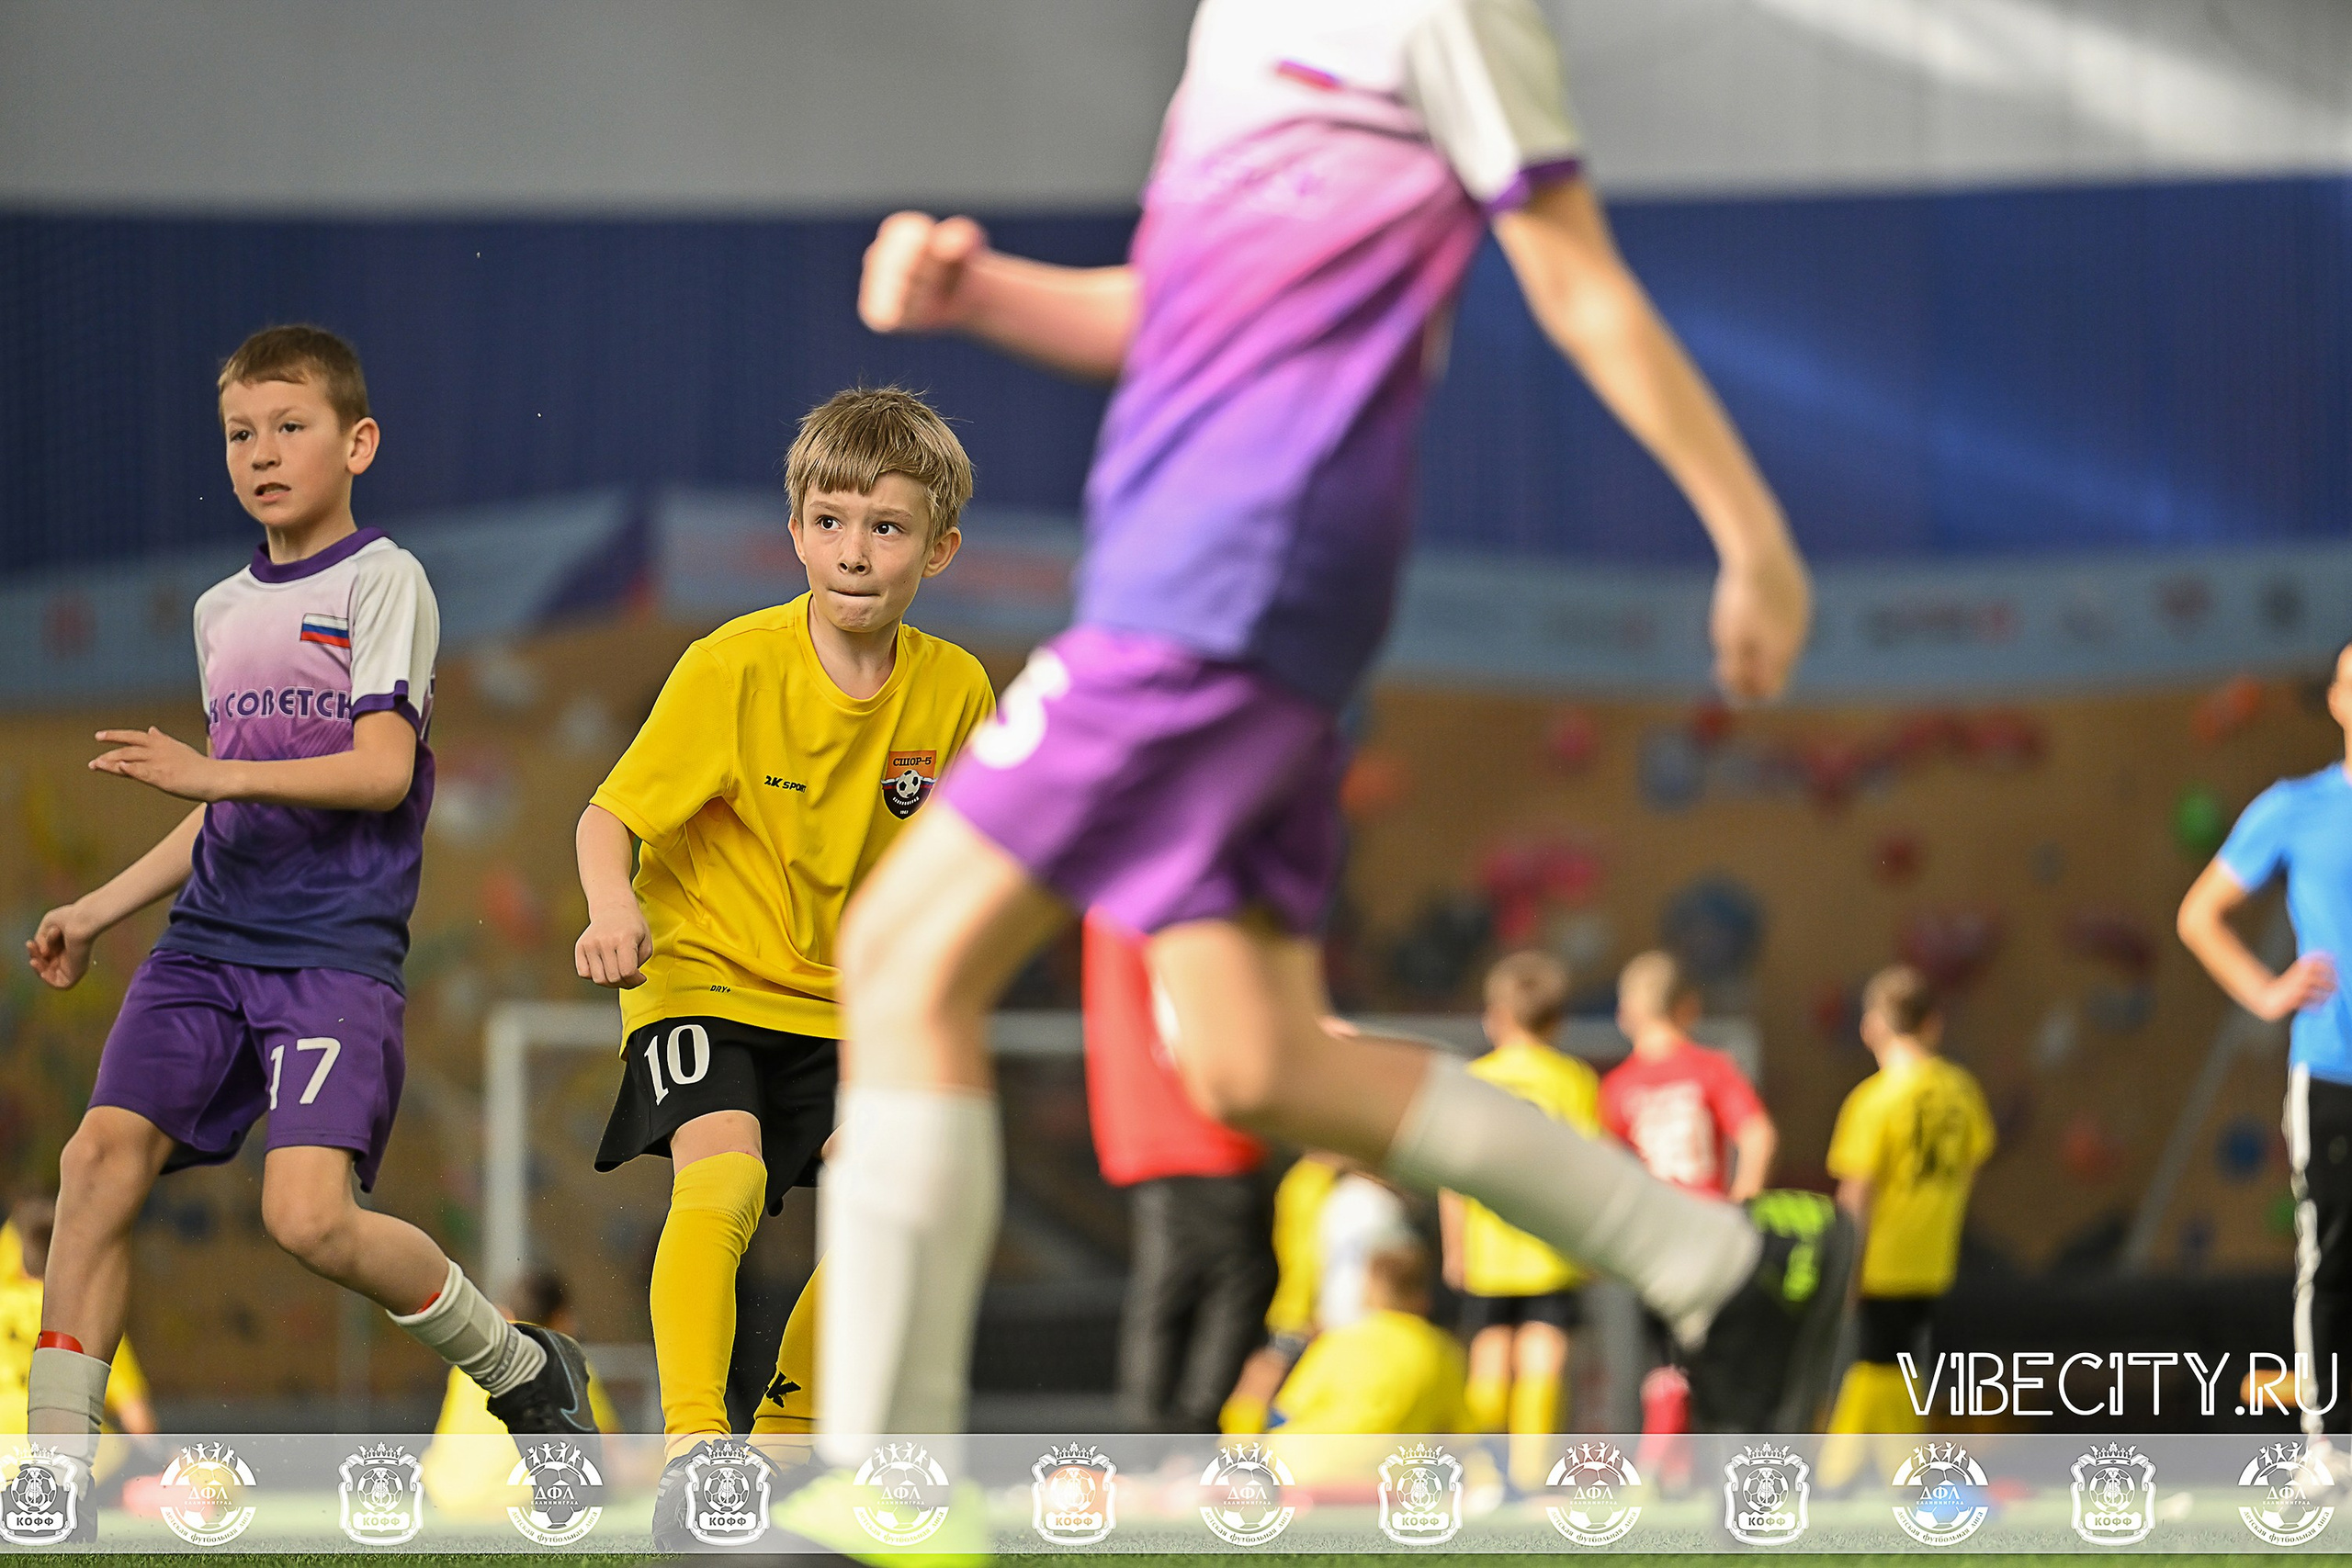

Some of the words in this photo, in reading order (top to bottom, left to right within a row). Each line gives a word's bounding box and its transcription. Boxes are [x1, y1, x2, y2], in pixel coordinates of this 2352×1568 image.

[763, 775, 784, 788] 2K
[892, 756, 933, 767] СШОР-5
[269, 1037, 341, 1111] 17
[644, 1024, 710, 1106] 10
